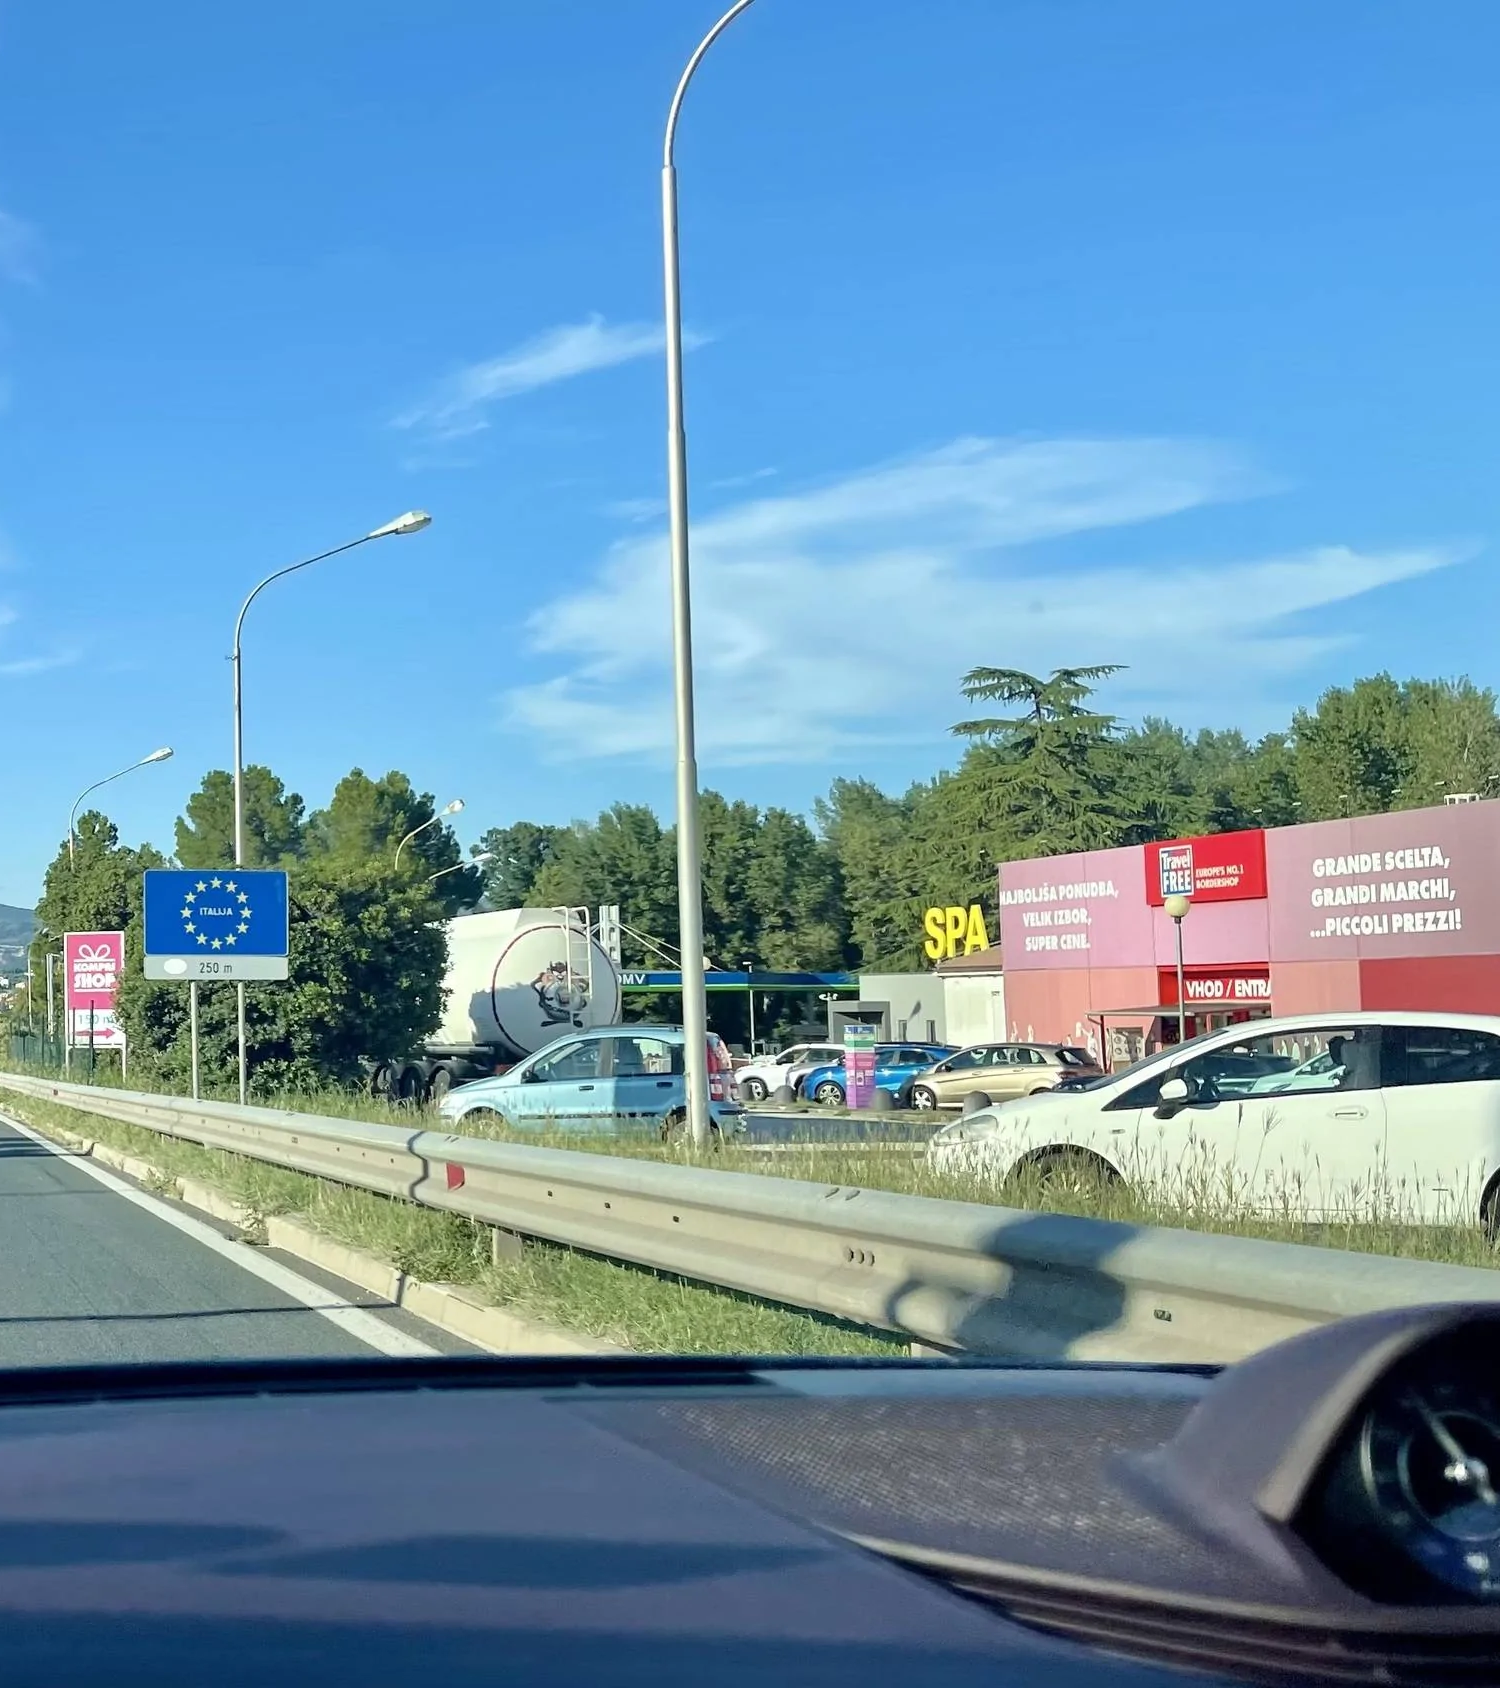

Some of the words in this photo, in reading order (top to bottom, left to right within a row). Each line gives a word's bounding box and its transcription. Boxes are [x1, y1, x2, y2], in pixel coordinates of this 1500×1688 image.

[1161, 850, 1190, 870] Travel
[1312, 852, 1381, 878] GRANDE
[1384, 846, 1450, 871] SCELTA,
[1058, 880, 1119, 900] PONUDBA,
[1163, 870, 1192, 893] FREE
[1196, 877, 1240, 889] BORDERSHOP
[1311, 883, 1377, 908] GRANDI
[1379, 878, 1456, 903] MARCHI,
[200, 907, 233, 916] ITALIJA
[1022, 910, 1052, 928] VELIK
[1054, 908, 1092, 926] IZBOR,
[924, 904, 990, 960] SPA
[1310, 914, 1389, 938] ...PICCOLI
[1392, 908, 1462, 934] PREZZI!
[1025, 935, 1058, 952] SUPER
[1061, 933, 1091, 951] CENE.
[200, 962, 220, 974] 250
[223, 964, 233, 974] m
[74, 973, 116, 988] SHOP
[1185, 980, 1224, 998] VHOD
[1225, 979, 1233, 998] /
